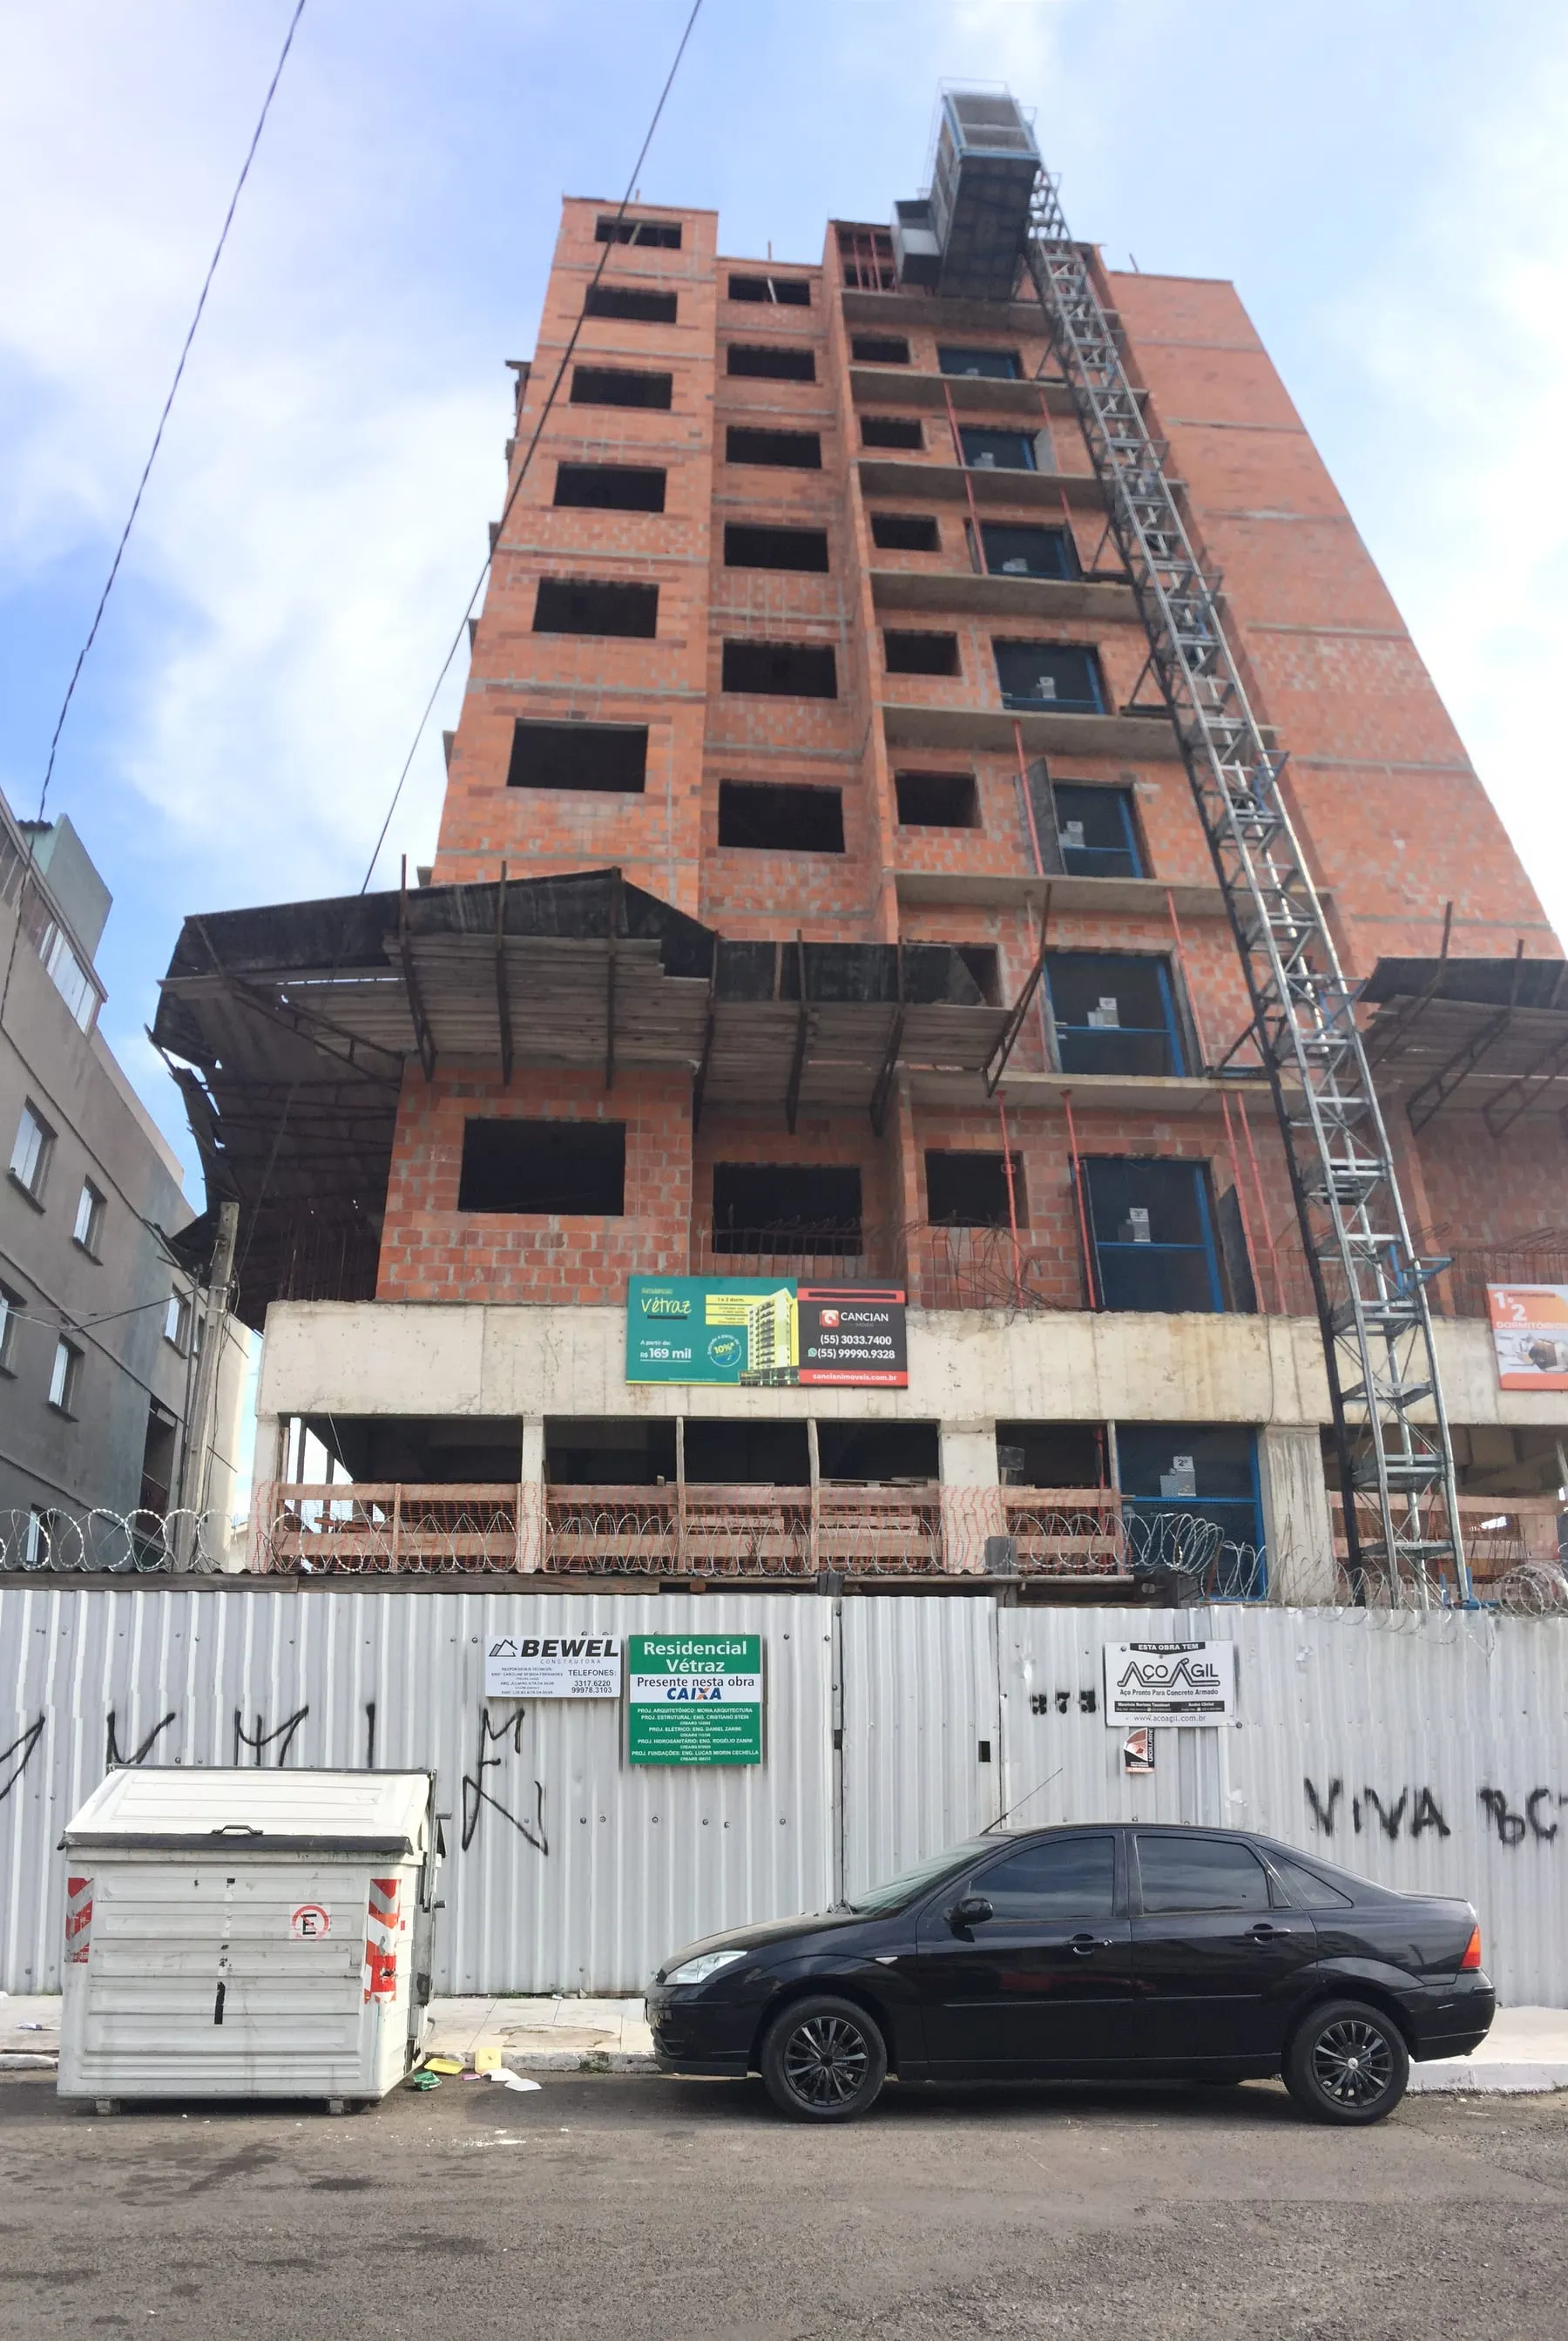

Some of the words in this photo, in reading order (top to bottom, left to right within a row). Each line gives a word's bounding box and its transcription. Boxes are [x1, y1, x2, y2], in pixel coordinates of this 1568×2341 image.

[841, 1312, 889, 1322] CANCIAN
[820, 1334, 839, 1345] (55)
[841, 1336, 892, 1345] 3033.7400
[649, 1347, 669, 1359] 169
[672, 1347, 692, 1359] mil
[817, 1348, 836, 1359] (55)
[838, 1349, 896, 1359] 99990.9328
[521, 1640, 618, 1657] BEWEL
[644, 1641, 747, 1655] Residencial
[666, 1658, 725, 1673] Vétraz
[637, 1676, 688, 1688] Presente
[693, 1677, 724, 1688] nesta
[727, 1675, 754, 1687] obra
[666, 1688, 721, 1700] CAIXA
[1304, 1777, 1451, 1840] VIVA
